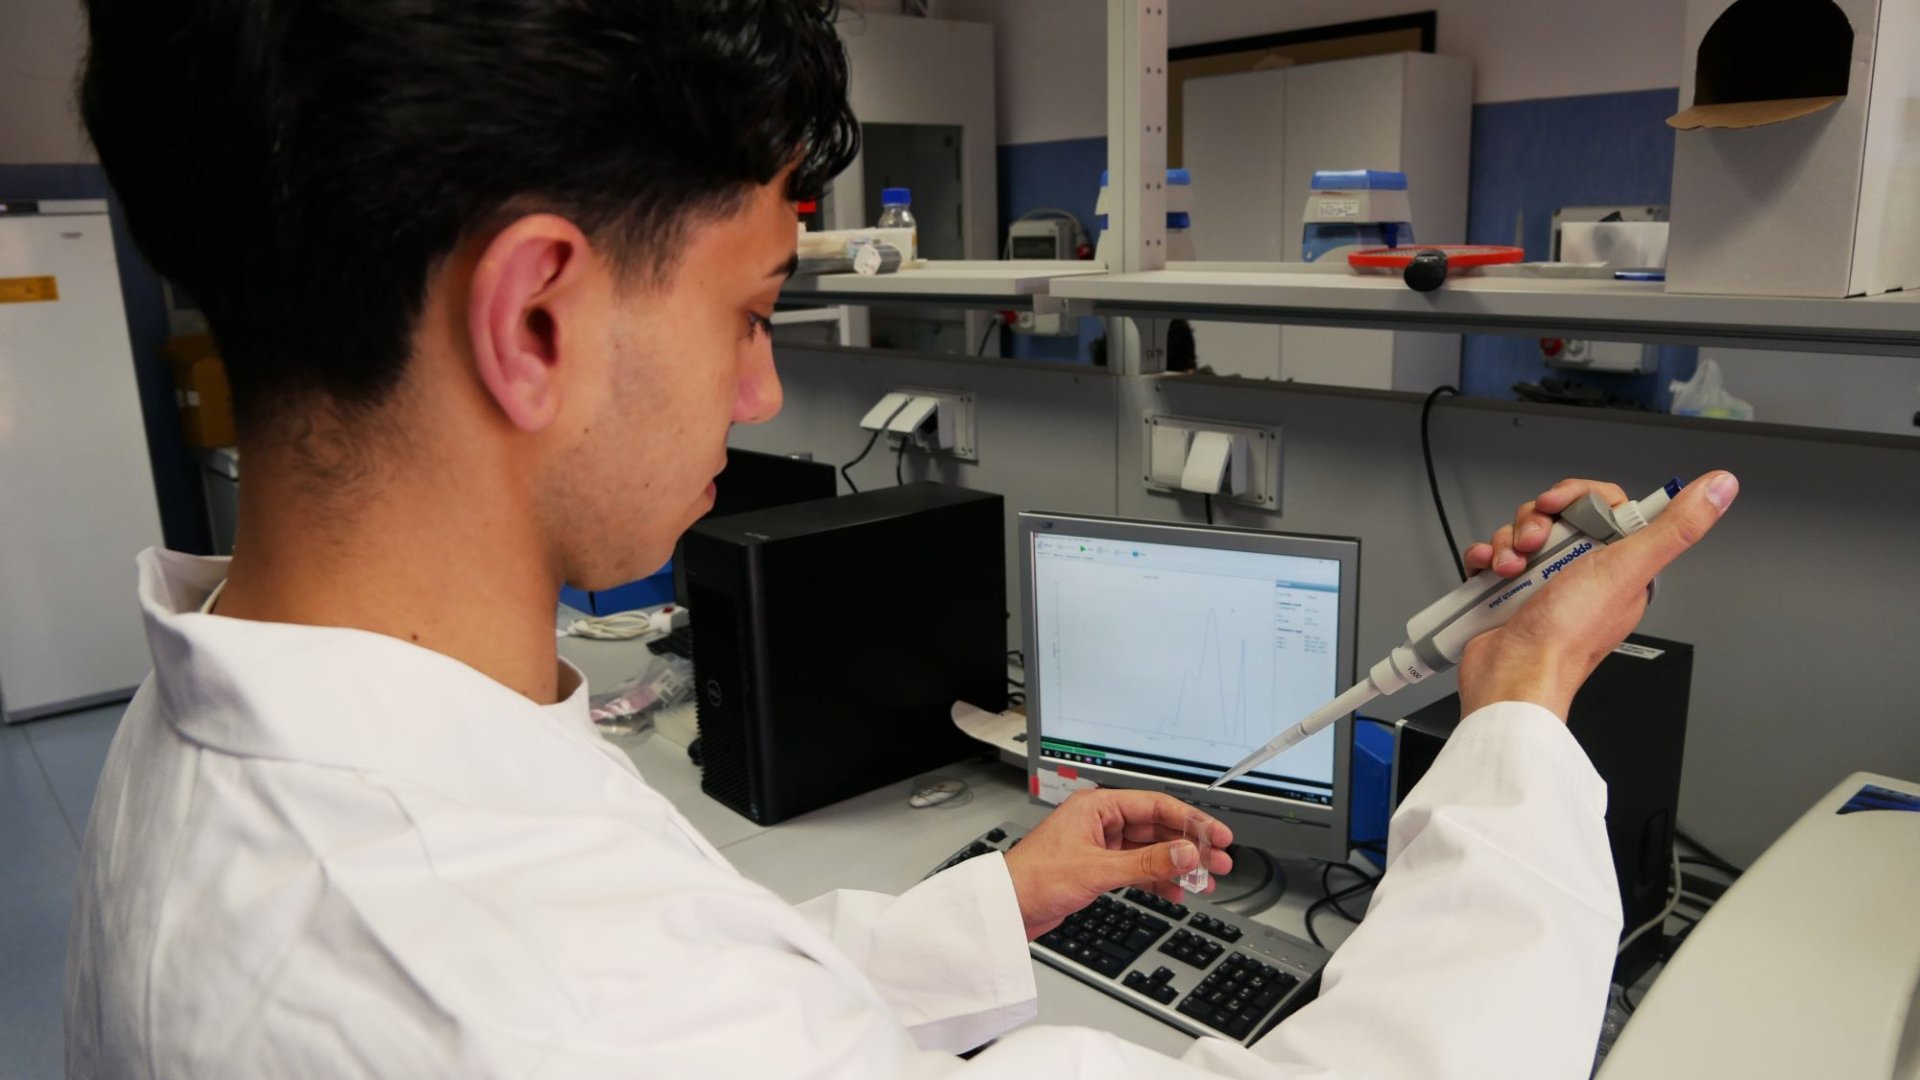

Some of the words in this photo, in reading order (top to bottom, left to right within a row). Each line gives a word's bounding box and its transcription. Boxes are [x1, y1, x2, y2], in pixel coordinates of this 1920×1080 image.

[1541, 542, 1593, 580] eppendorf
[1503, 579, 1532, 600] Research
[1489, 594, 1502, 608] plus
